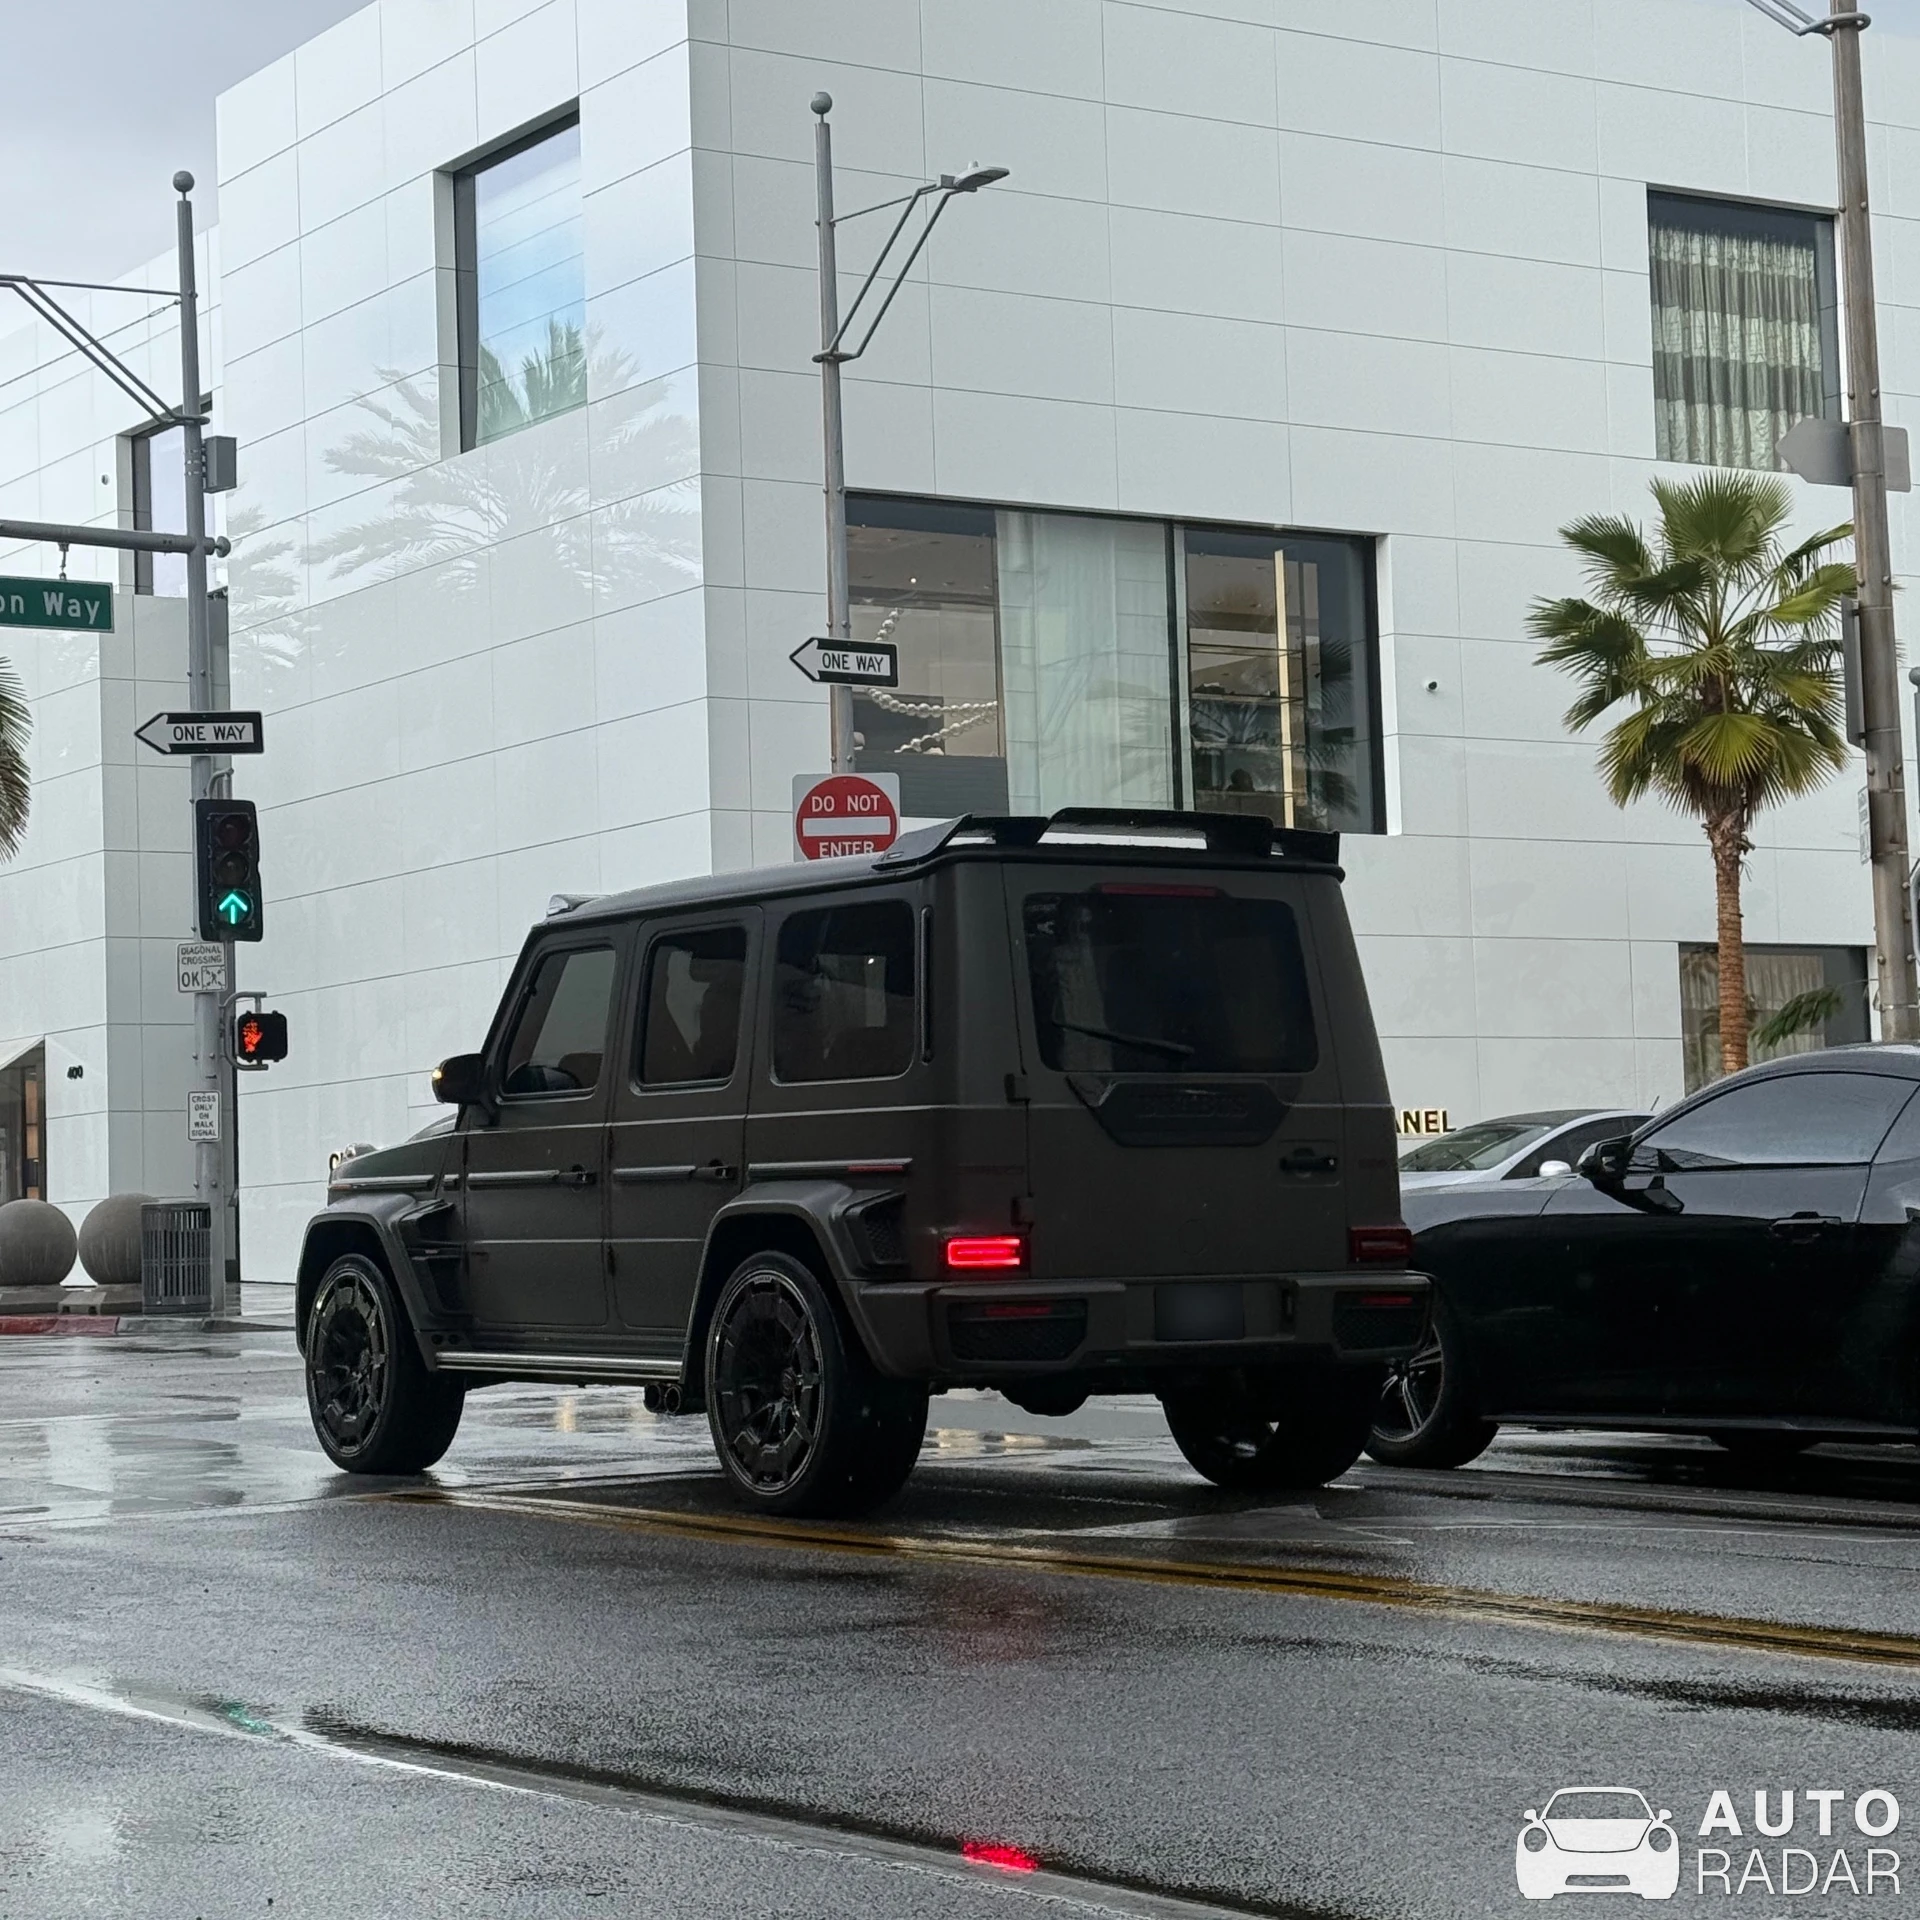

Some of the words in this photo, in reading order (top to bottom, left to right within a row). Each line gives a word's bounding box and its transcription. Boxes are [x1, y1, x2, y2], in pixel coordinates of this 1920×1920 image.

[42, 591, 100, 625] Way
[822, 652, 850, 670] ONE
[856, 655, 884, 673] WAY
[173, 725, 206, 741] ONE
[213, 725, 246, 741] WAY
[812, 795, 835, 812] DO
[847, 795, 880, 812] NOT
[819, 841, 874, 857] ENTER
[181, 945, 222, 956] DIAGONAL
[181, 955, 222, 966] CROSSING
[181, 971, 200, 987] OK
[191, 1095, 216, 1103] CROSS
[194, 1103, 213, 1111] ONLY
[194, 1120, 214, 1128] WALK
[191, 1129, 217, 1137] SIGNAL
